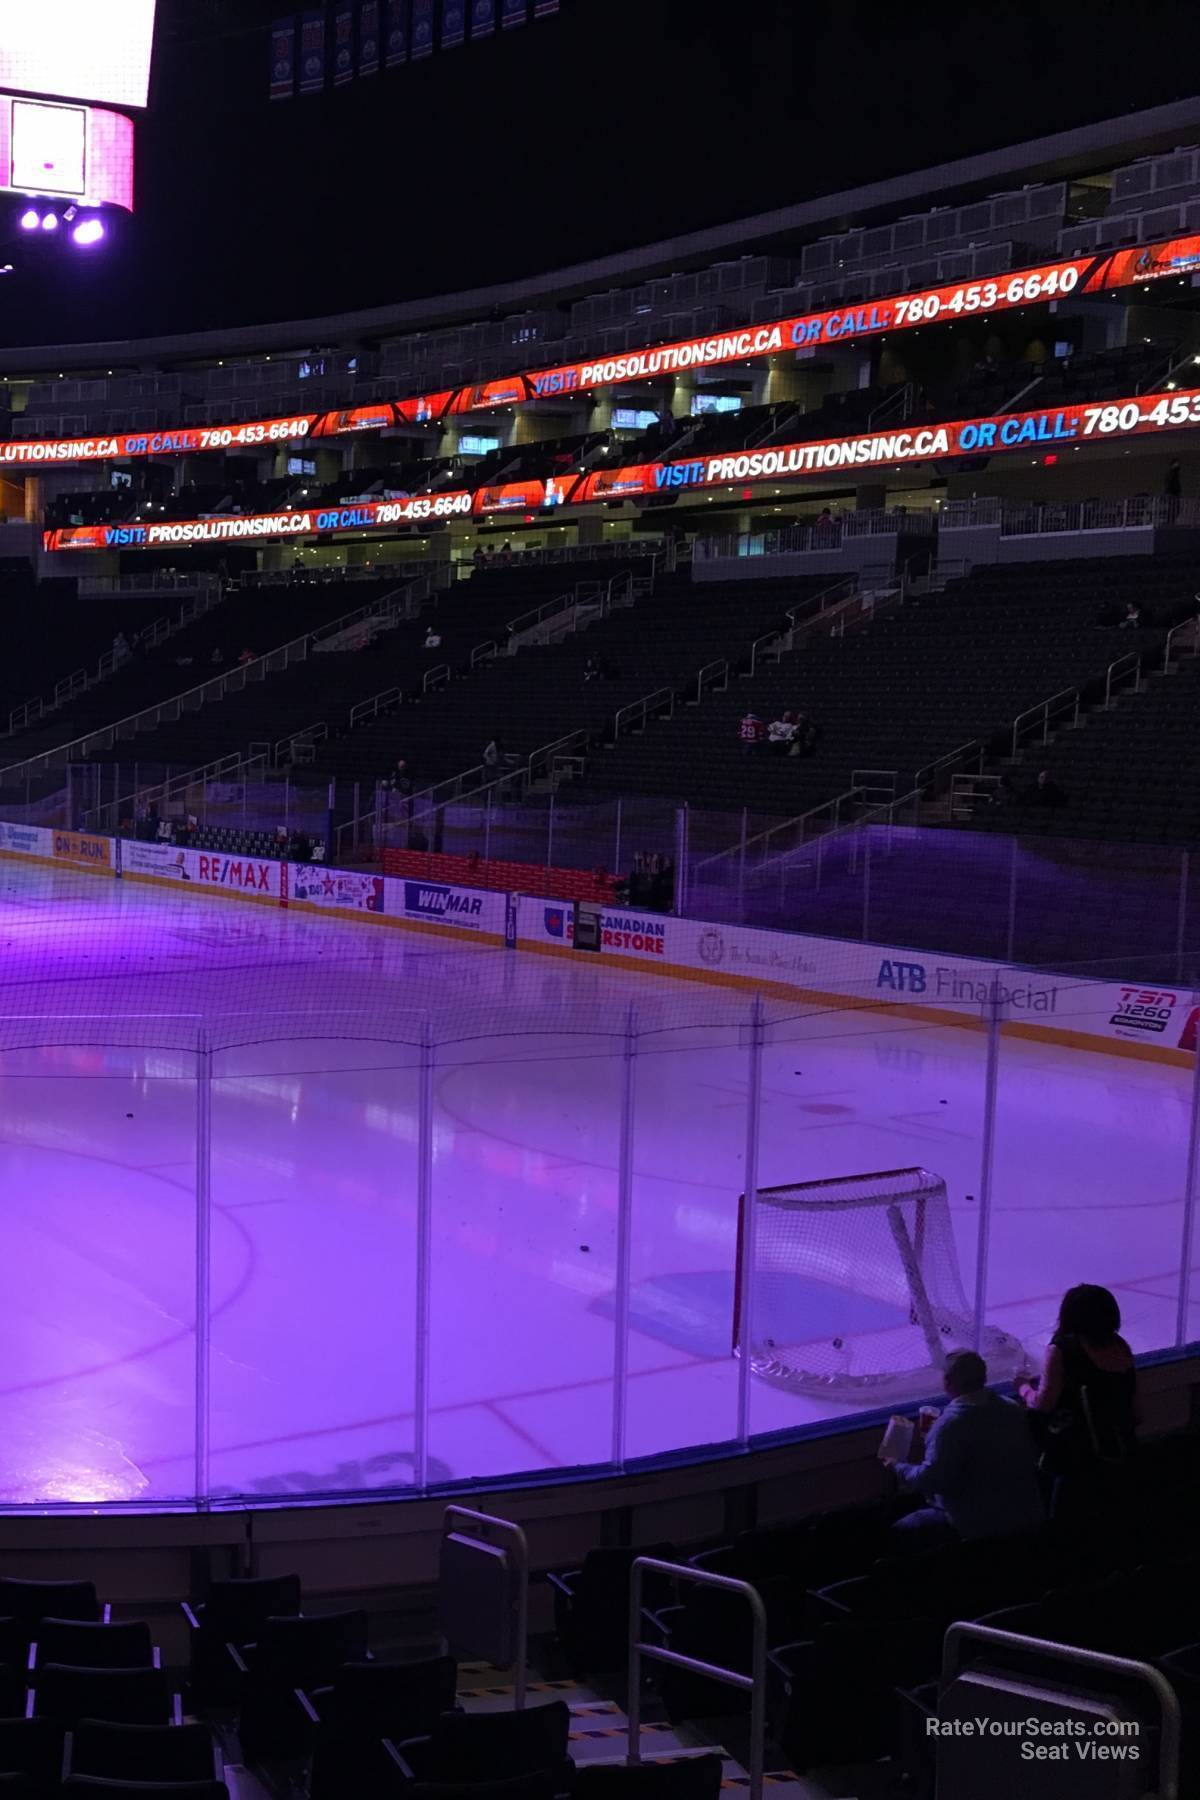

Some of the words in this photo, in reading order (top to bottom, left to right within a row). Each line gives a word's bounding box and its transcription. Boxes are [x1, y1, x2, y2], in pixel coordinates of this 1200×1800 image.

[535, 371, 577, 395] VISIT:
[580, 327, 782, 386] PROSOLUTIONSINC.CA
[791, 321, 820, 344] OR
[826, 308, 891, 336] CALL:
[894, 267, 1078, 325] 780-453-6640
[125, 436, 147, 453] OR
[151, 432, 196, 452] CALL:
[200, 419, 309, 448] 780-453-6640
[654, 462, 704, 488] VISIT:
[706, 429, 949, 481] PROSOLUTIONSINC.CA
[959, 423, 996, 450] OR
[1000, 412, 1079, 444] CALL:
[105, 527, 147, 544] VISIT:
[149, 514, 311, 543] PROSOLUTIONSINC.CA
[317, 511, 338, 529] OR
[340, 507, 374, 528] CALL:
[376, 494, 471, 522] 780-453-6640
[56, 836, 71, 854] ON
[80, 839, 105, 860] RUN
[199, 854, 271, 891] RE/MAX
[418, 889, 483, 916] WINMAR
[876, 960, 928, 993] ATB
[936, 967, 1058, 1014] Financial
[1120, 986, 1177, 1008] TSN
[1124, 1003, 1172, 1020] 1260
